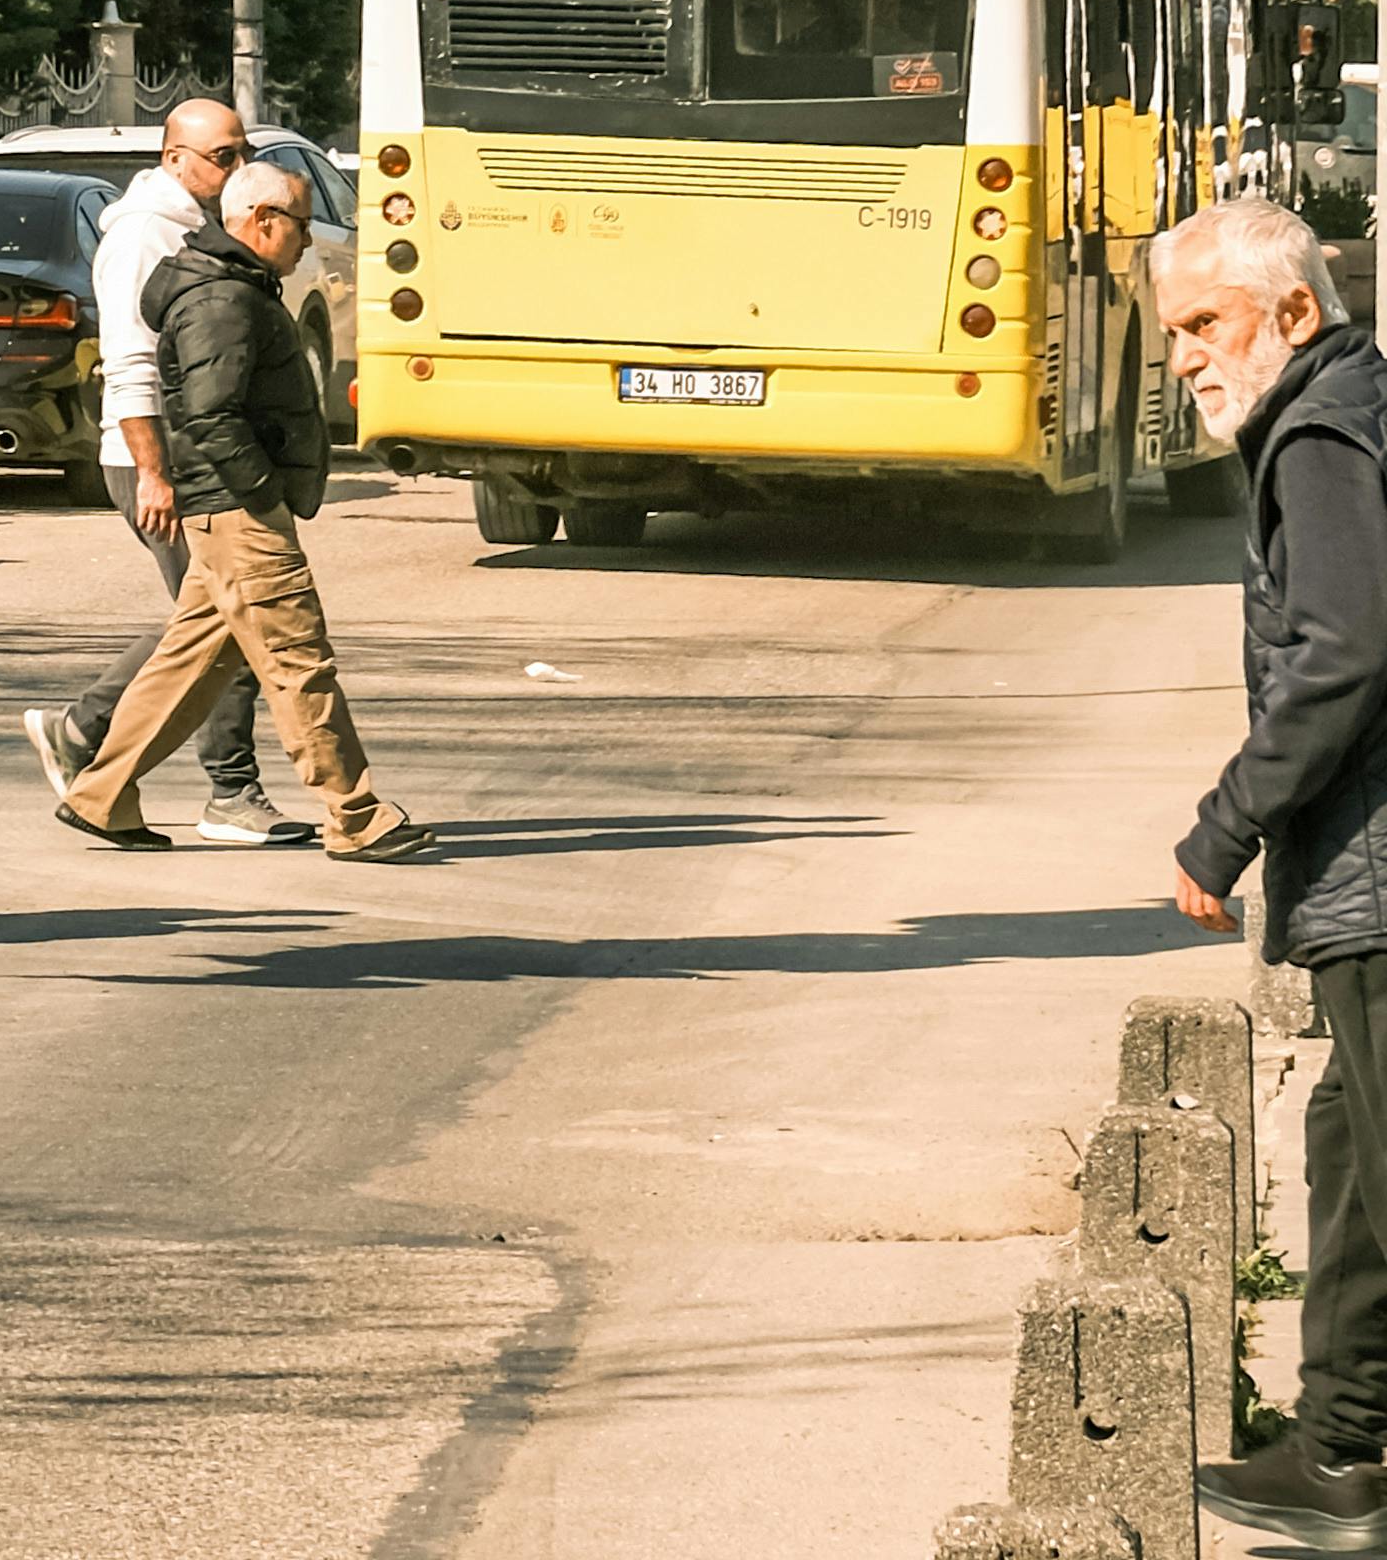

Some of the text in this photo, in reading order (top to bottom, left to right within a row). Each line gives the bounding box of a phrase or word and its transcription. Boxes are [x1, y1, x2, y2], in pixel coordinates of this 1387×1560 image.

[858, 205, 932, 231] C-1919
[633, 371, 659, 394] 34
[709, 374, 760, 397] 3867
